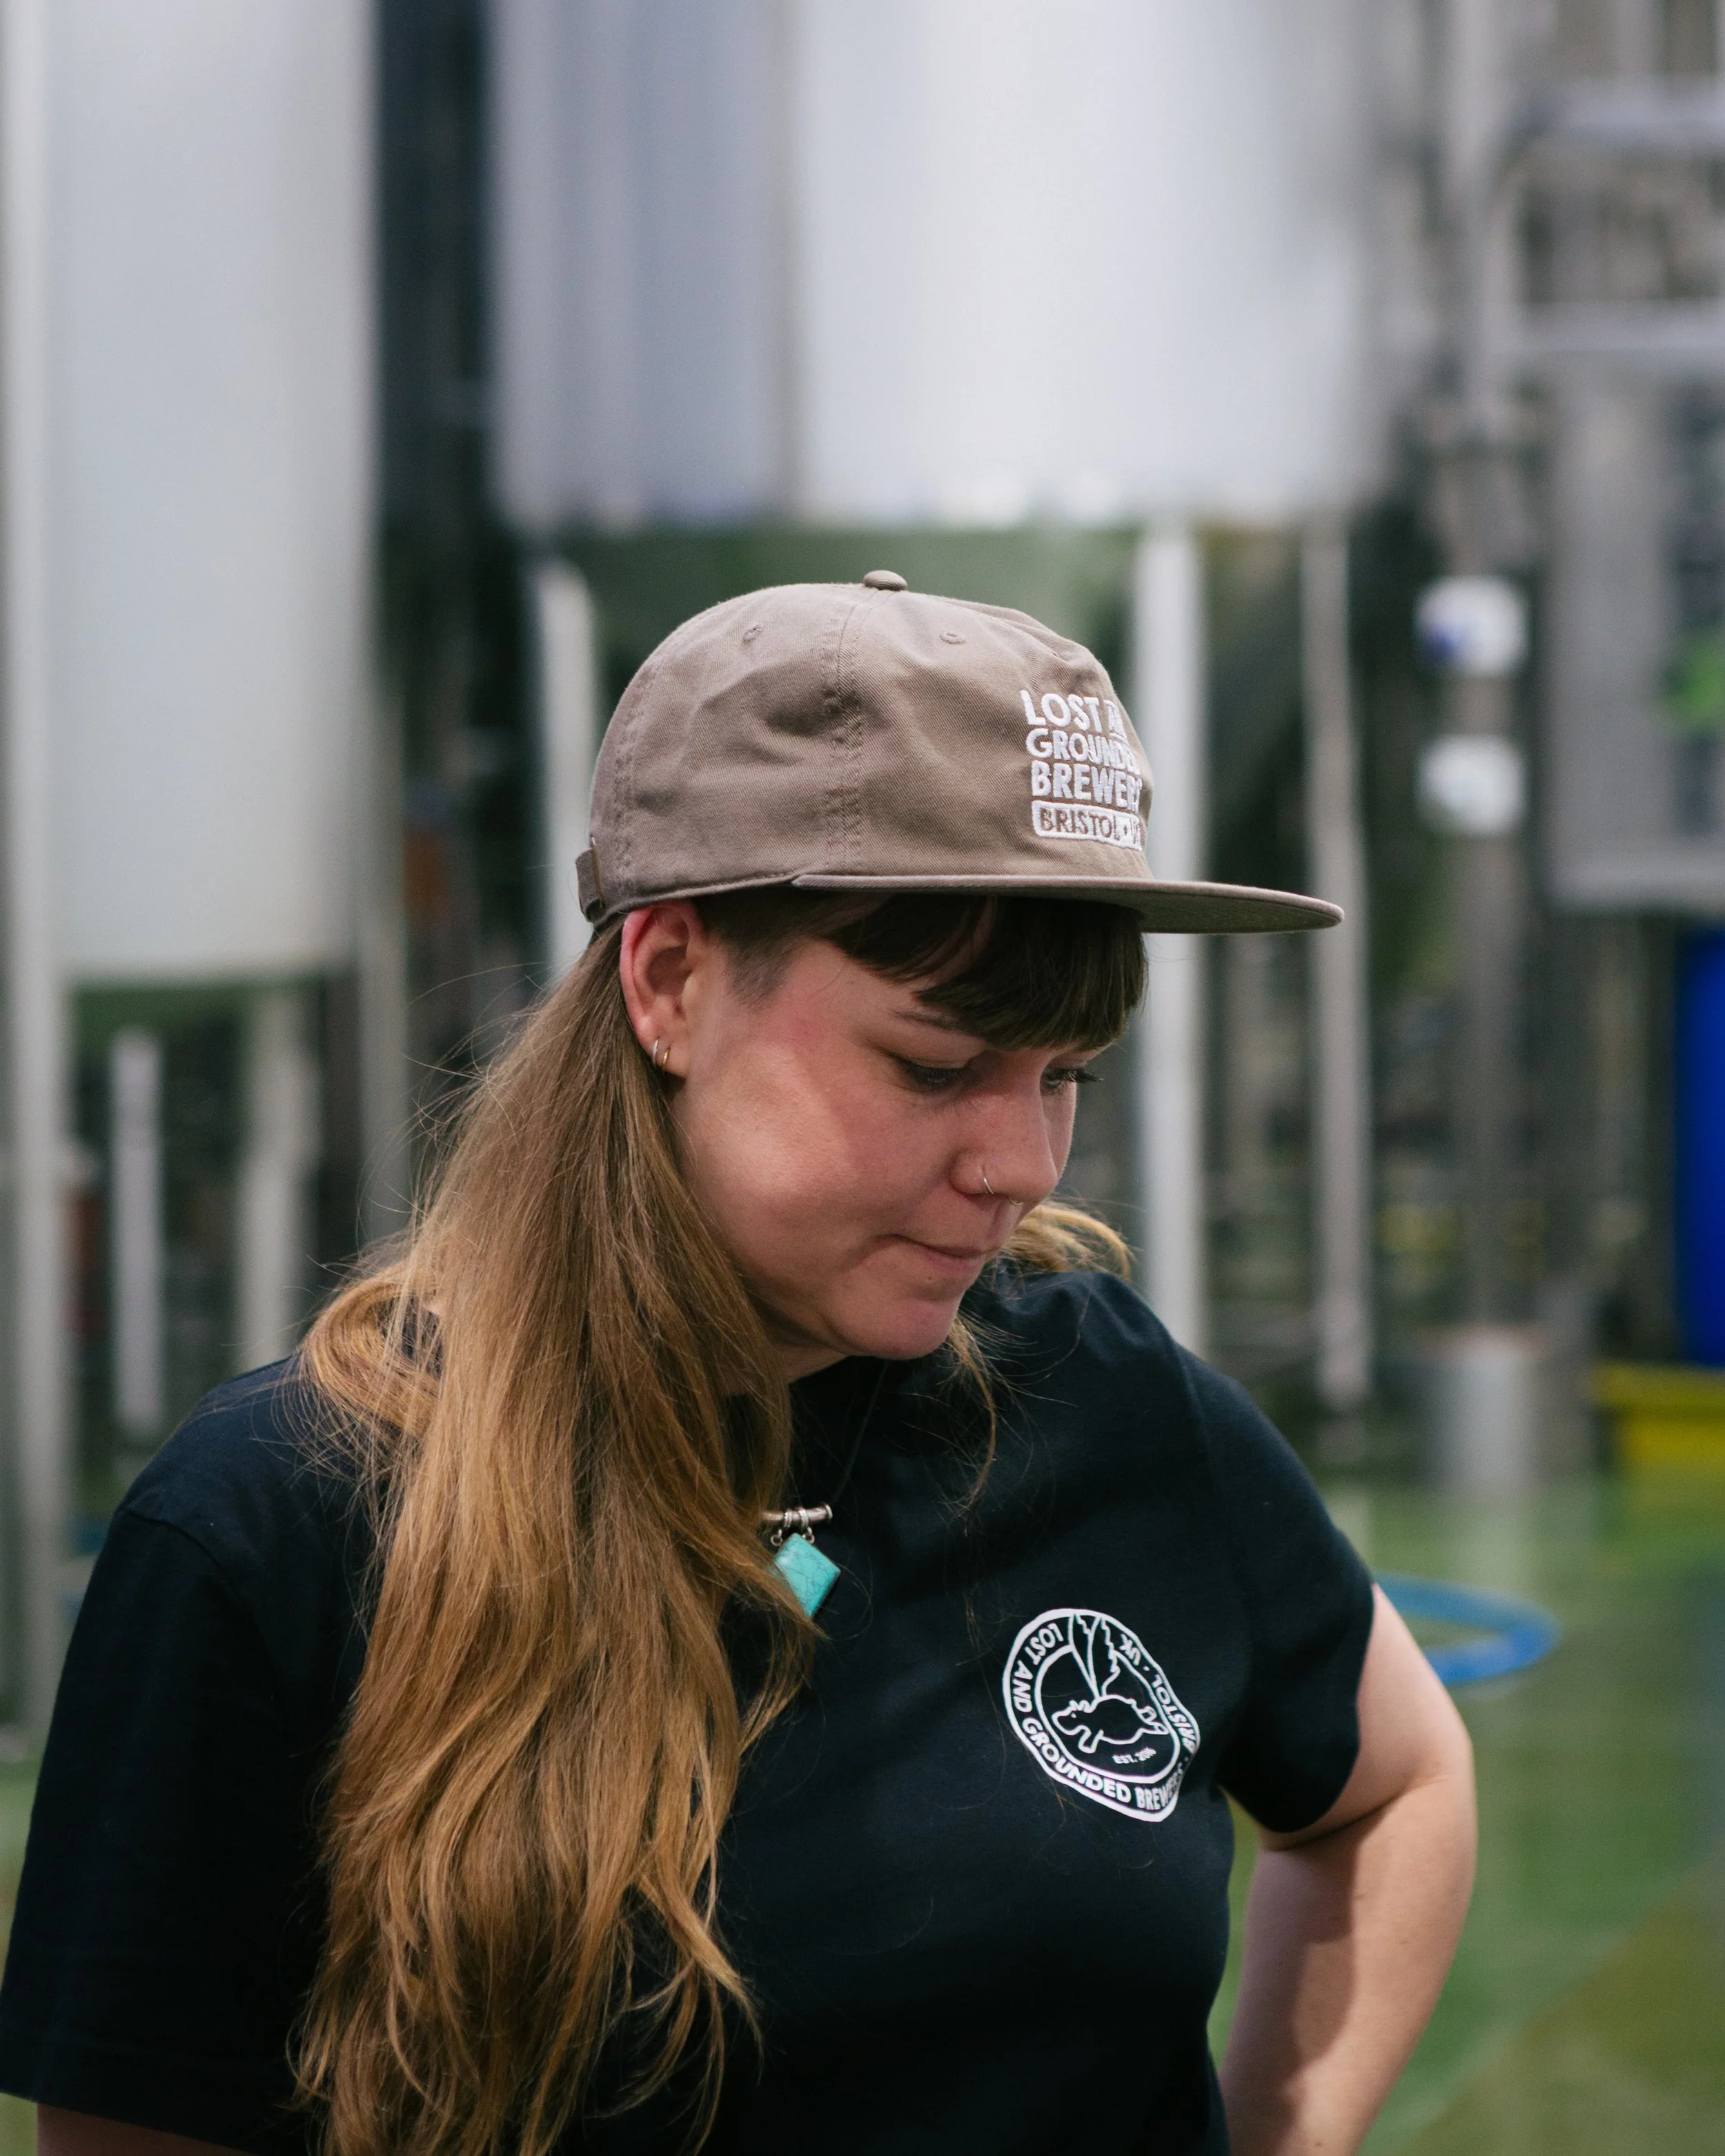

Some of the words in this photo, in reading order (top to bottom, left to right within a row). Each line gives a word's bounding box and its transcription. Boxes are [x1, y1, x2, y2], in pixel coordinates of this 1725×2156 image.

[1020, 689, 1103, 733] LOST
[1025, 728, 1141, 775] GROUND
[1040, 808, 1121, 840] BRISTOL
[1024, 1623, 1064, 1665] LOST
[1119, 1634, 1142, 1666] UK
[1012, 1659, 1034, 1713] AND
[1152, 1674, 1196, 1754] BRISTOL
[1022, 1718, 1132, 1803] GROUNDED
[1112, 1754, 1138, 1764] EST.
